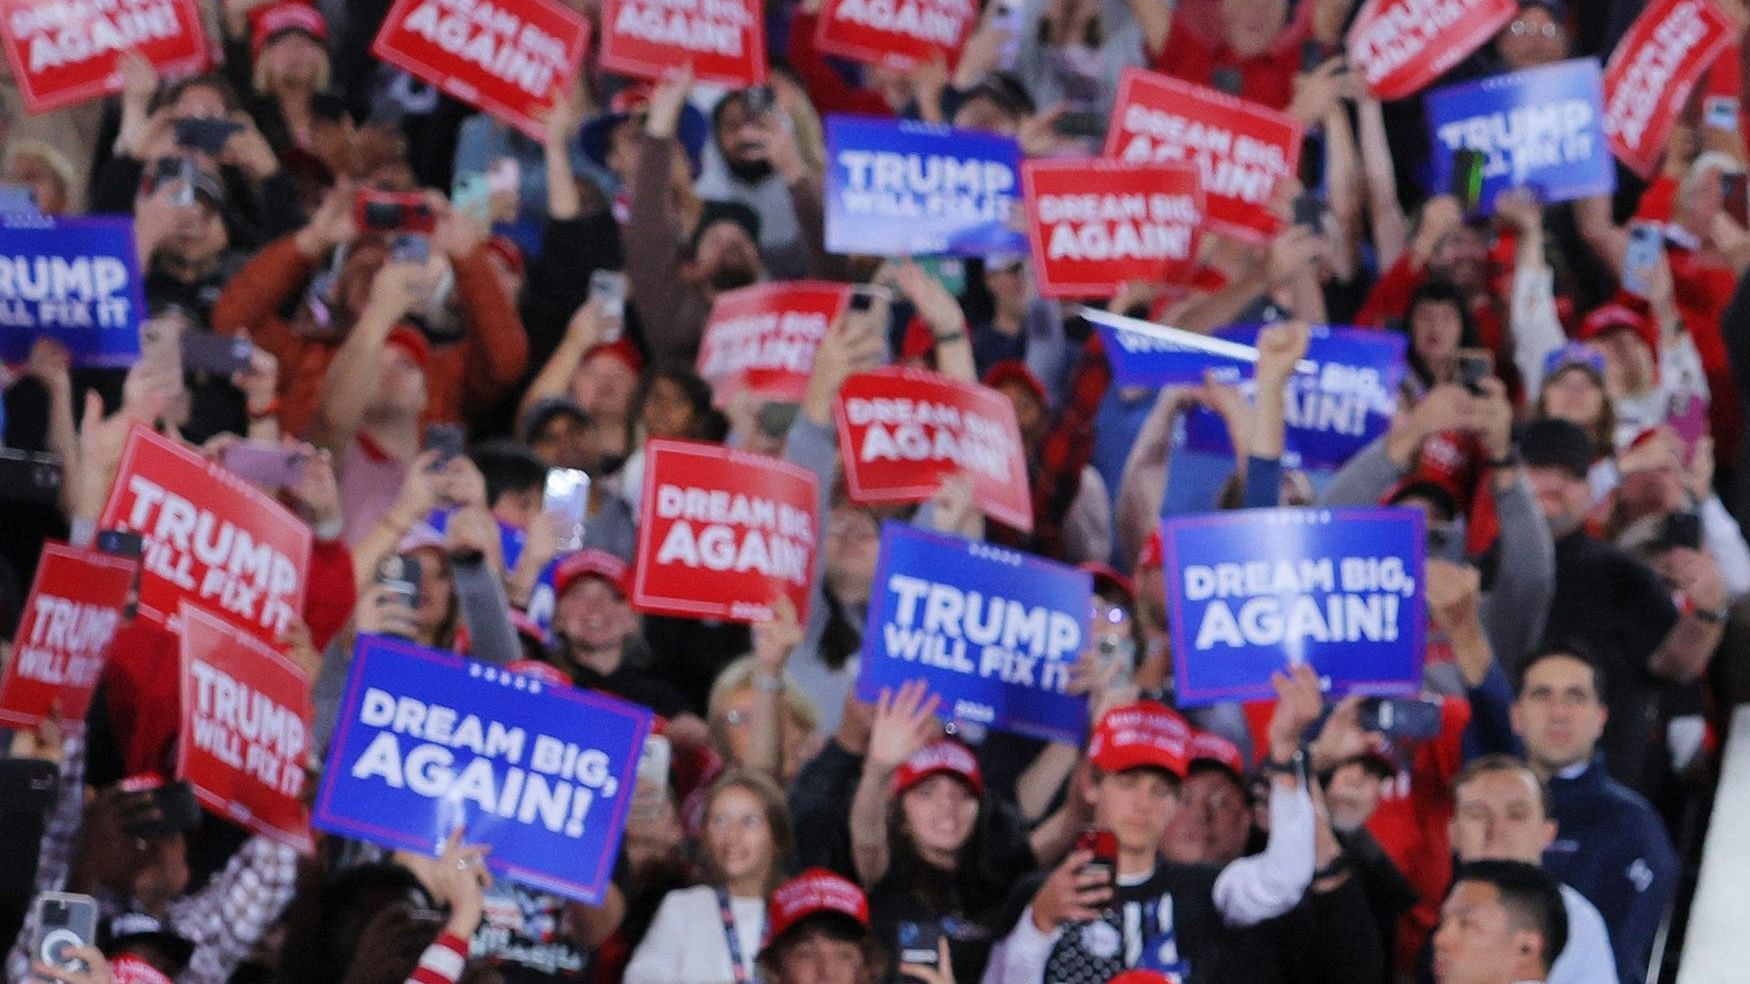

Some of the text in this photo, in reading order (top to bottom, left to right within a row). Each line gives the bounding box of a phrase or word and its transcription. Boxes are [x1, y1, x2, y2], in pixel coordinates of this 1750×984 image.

[403, 2, 552, 98] AGAIN!
[615, 5, 744, 57] AGAIN!
[1124, 103, 1233, 153] DREAM
[1437, 102, 1594, 151] TRUMP
[839, 149, 1014, 196] TRUMP
[1037, 192, 1201, 226] DREAM BIG,
[1048, 220, 1193, 261] AGAIN!
[0, 254, 129, 303] RUMP
[95, 296, 130, 328] IT
[846, 397, 960, 428] DREAM
[1320, 362, 1398, 416] BIG,
[861, 423, 1012, 484] AGAIN!
[130, 474, 299, 597] TRUMP
[657, 484, 777, 531] DREAM
[138, 528, 296, 636] ILL FIX IT
[656, 520, 810, 587] AGAIN!
[1184, 555, 1416, 602] DREAM BIG,
[30, 593, 123, 655] TRUMP
[888, 573, 1082, 661] TRUMP
[1194, 592, 1401, 652] AGAIN!
[15, 646, 64, 686] WILL
[883, 621, 975, 674] WILL
[978, 643, 1038, 687] FIX
[190, 658, 306, 764] TRUMP
[191, 714, 306, 799] WILL FIX IT
[358, 685, 619, 799] DREAM BIG,
[350, 730, 594, 839] AGAIN!
